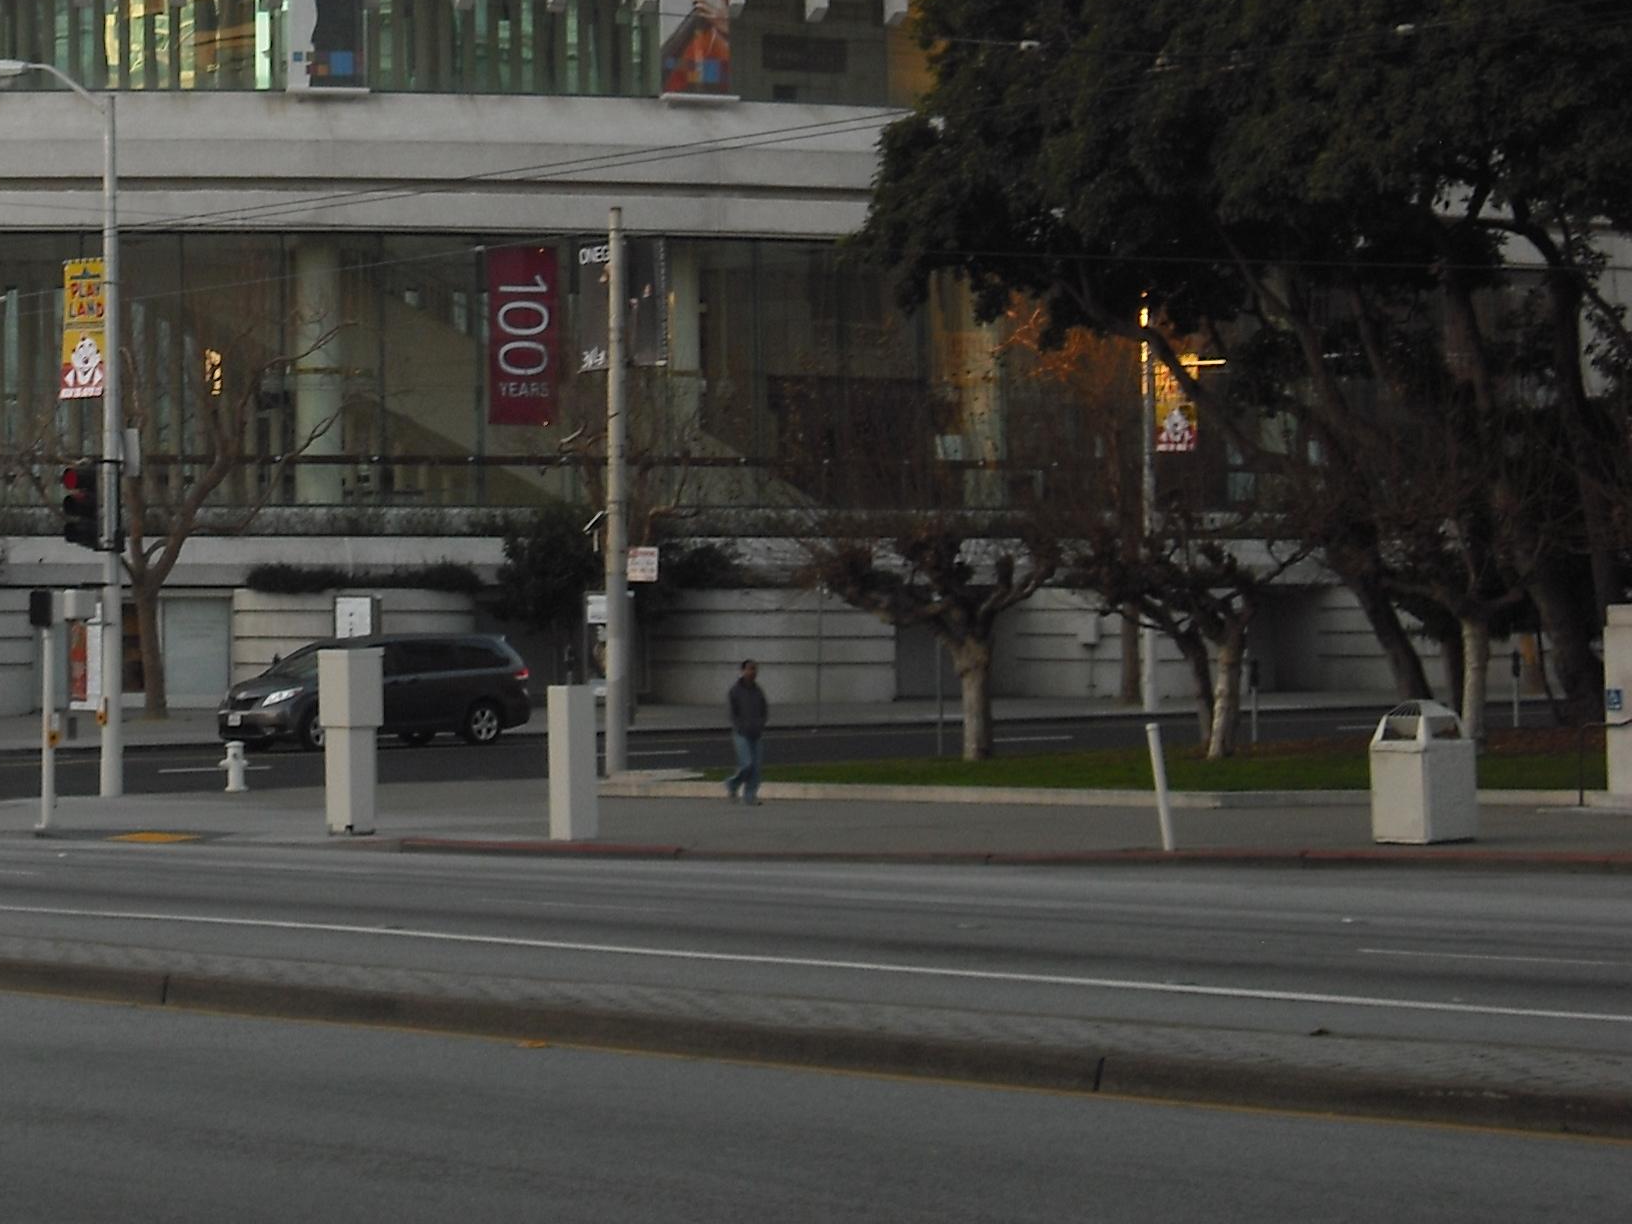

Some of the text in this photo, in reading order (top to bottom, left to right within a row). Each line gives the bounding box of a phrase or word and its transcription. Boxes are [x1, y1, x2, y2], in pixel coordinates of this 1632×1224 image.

[70, 282, 101, 297] PLAY
[70, 301, 104, 318] LAND
[497, 274, 549, 376] 100
[499, 382, 549, 398] YEARS
